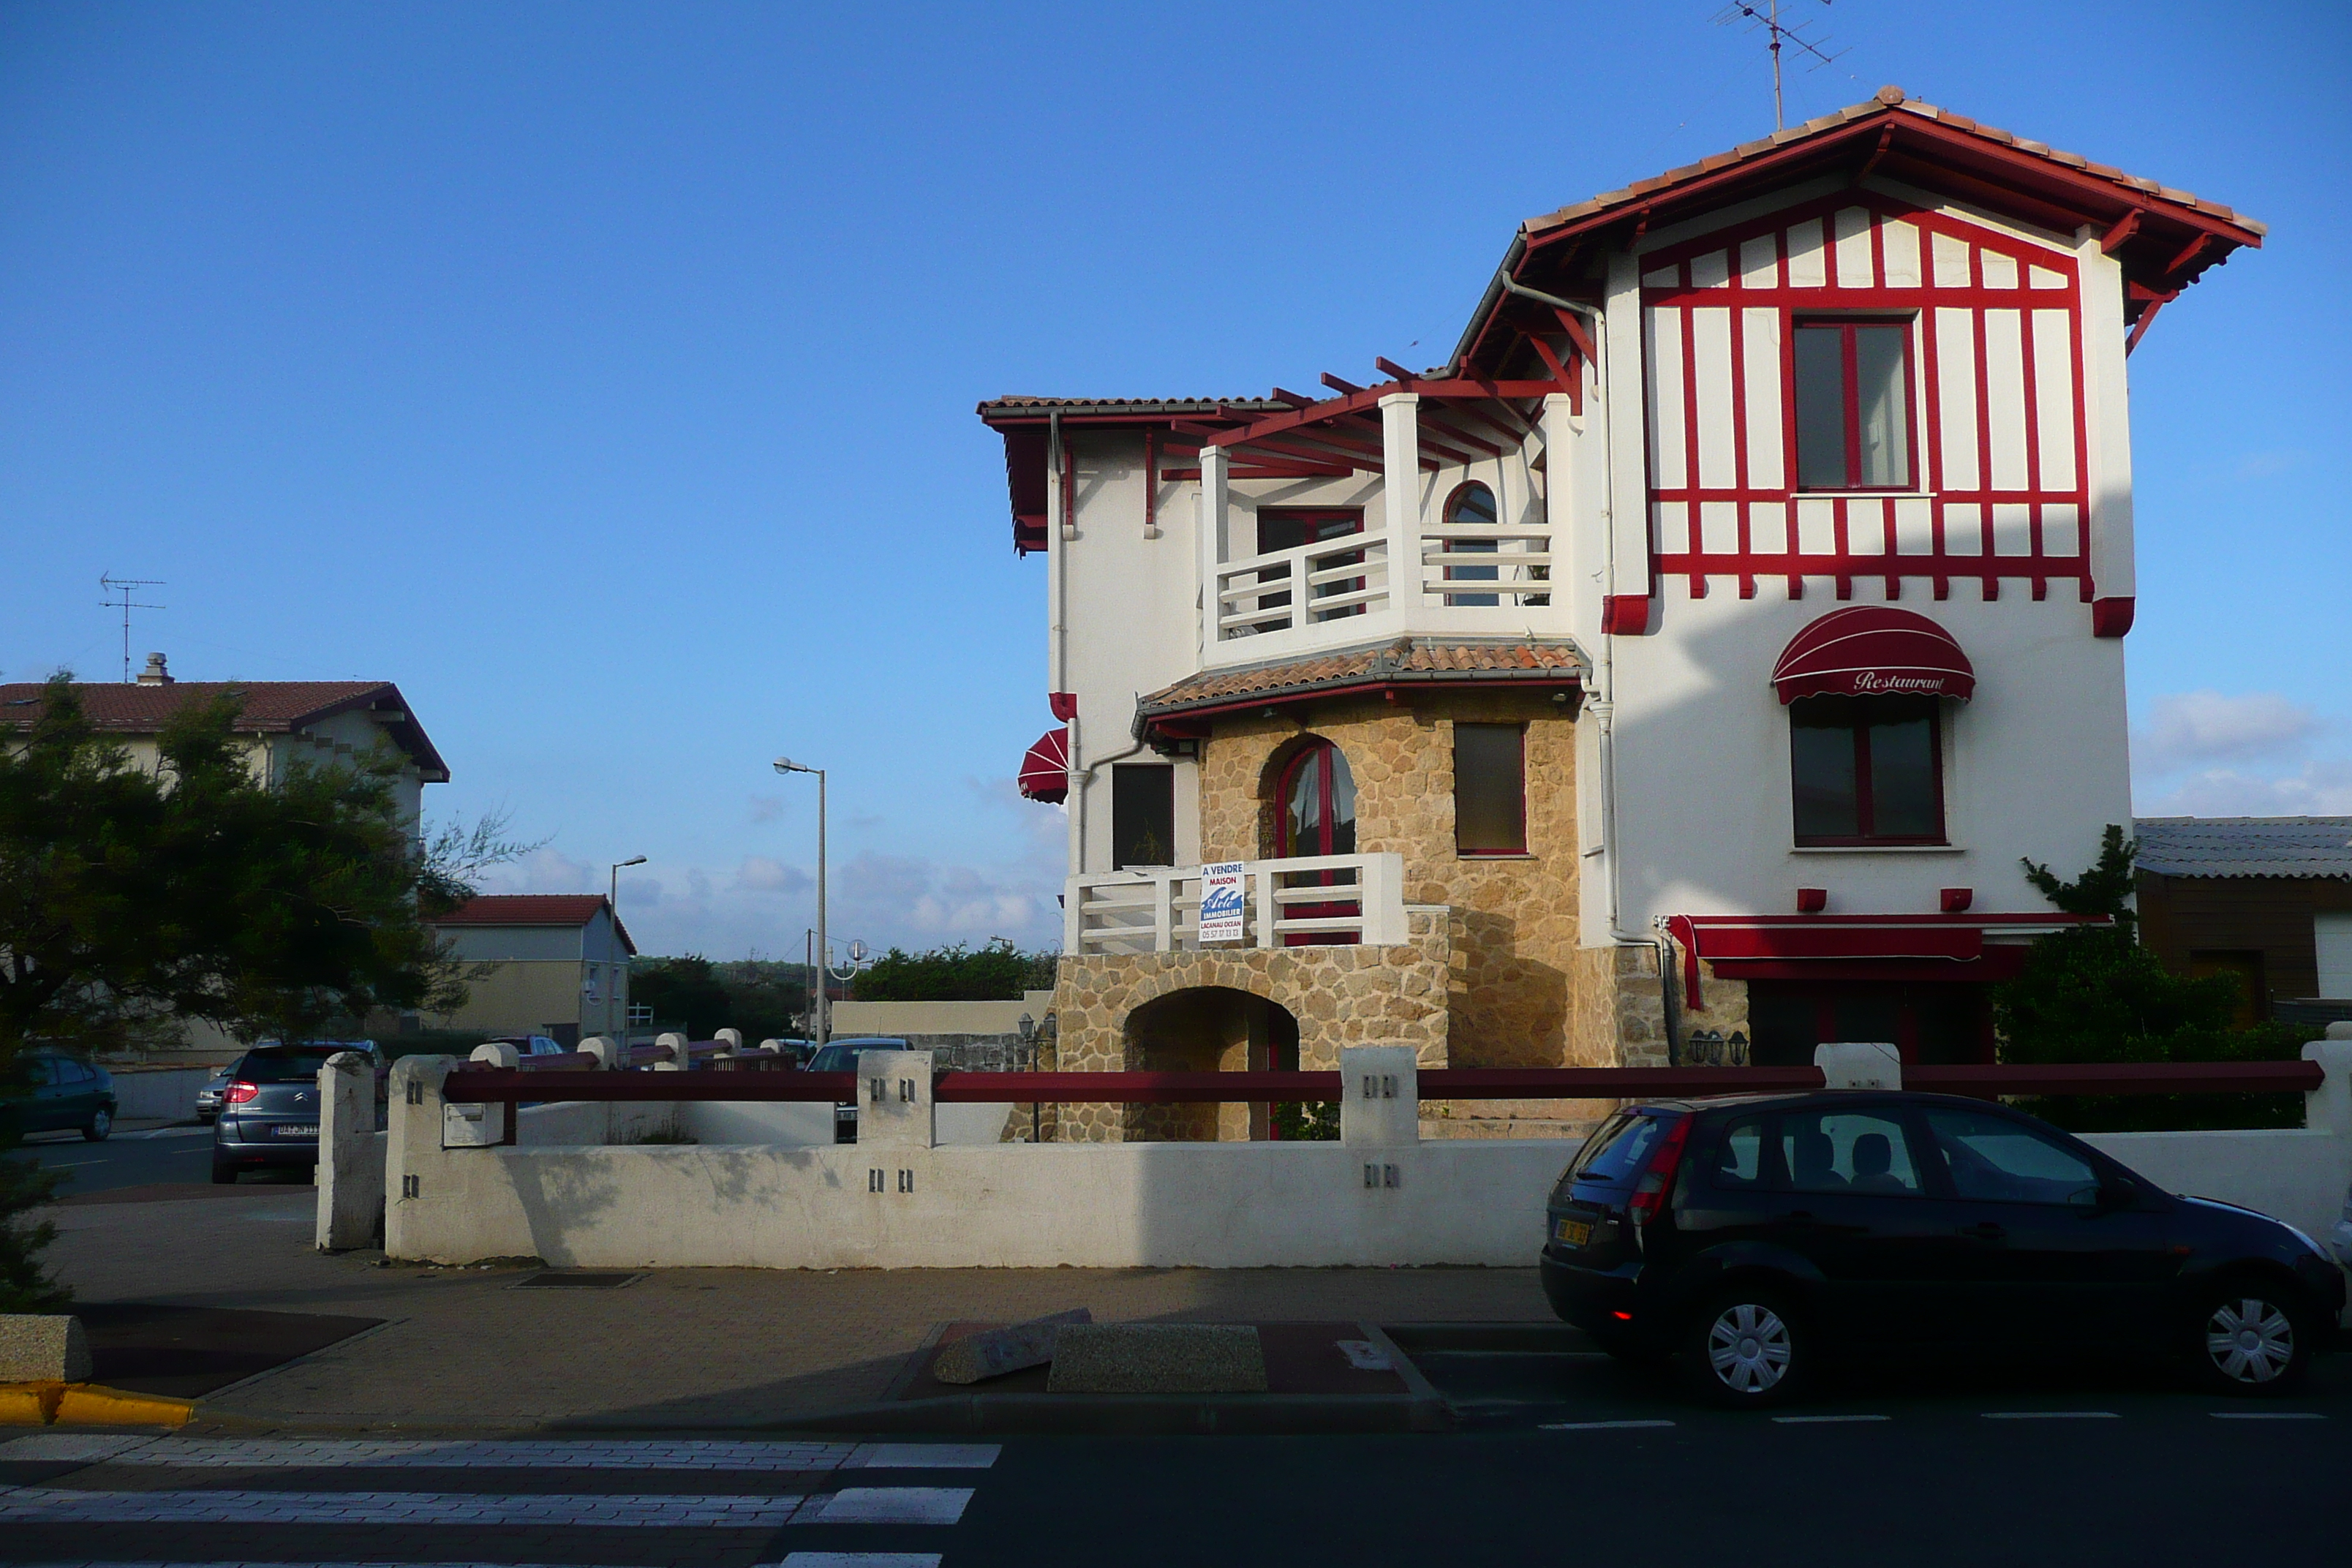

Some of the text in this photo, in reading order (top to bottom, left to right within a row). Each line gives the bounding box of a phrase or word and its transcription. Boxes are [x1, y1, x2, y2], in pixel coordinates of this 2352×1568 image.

[1853, 671, 1945, 690] Restaurant
[1203, 864, 1242, 876] A VENDRE
[1210, 876, 1237, 886] MAISON
[1204, 908, 1240, 919] IMMOBILIER
[1202, 930, 1210, 938] 05
[1210, 930, 1218, 938] 57
[1219, 930, 1225, 938] 17
[1232, 929, 1239, 937] 13
